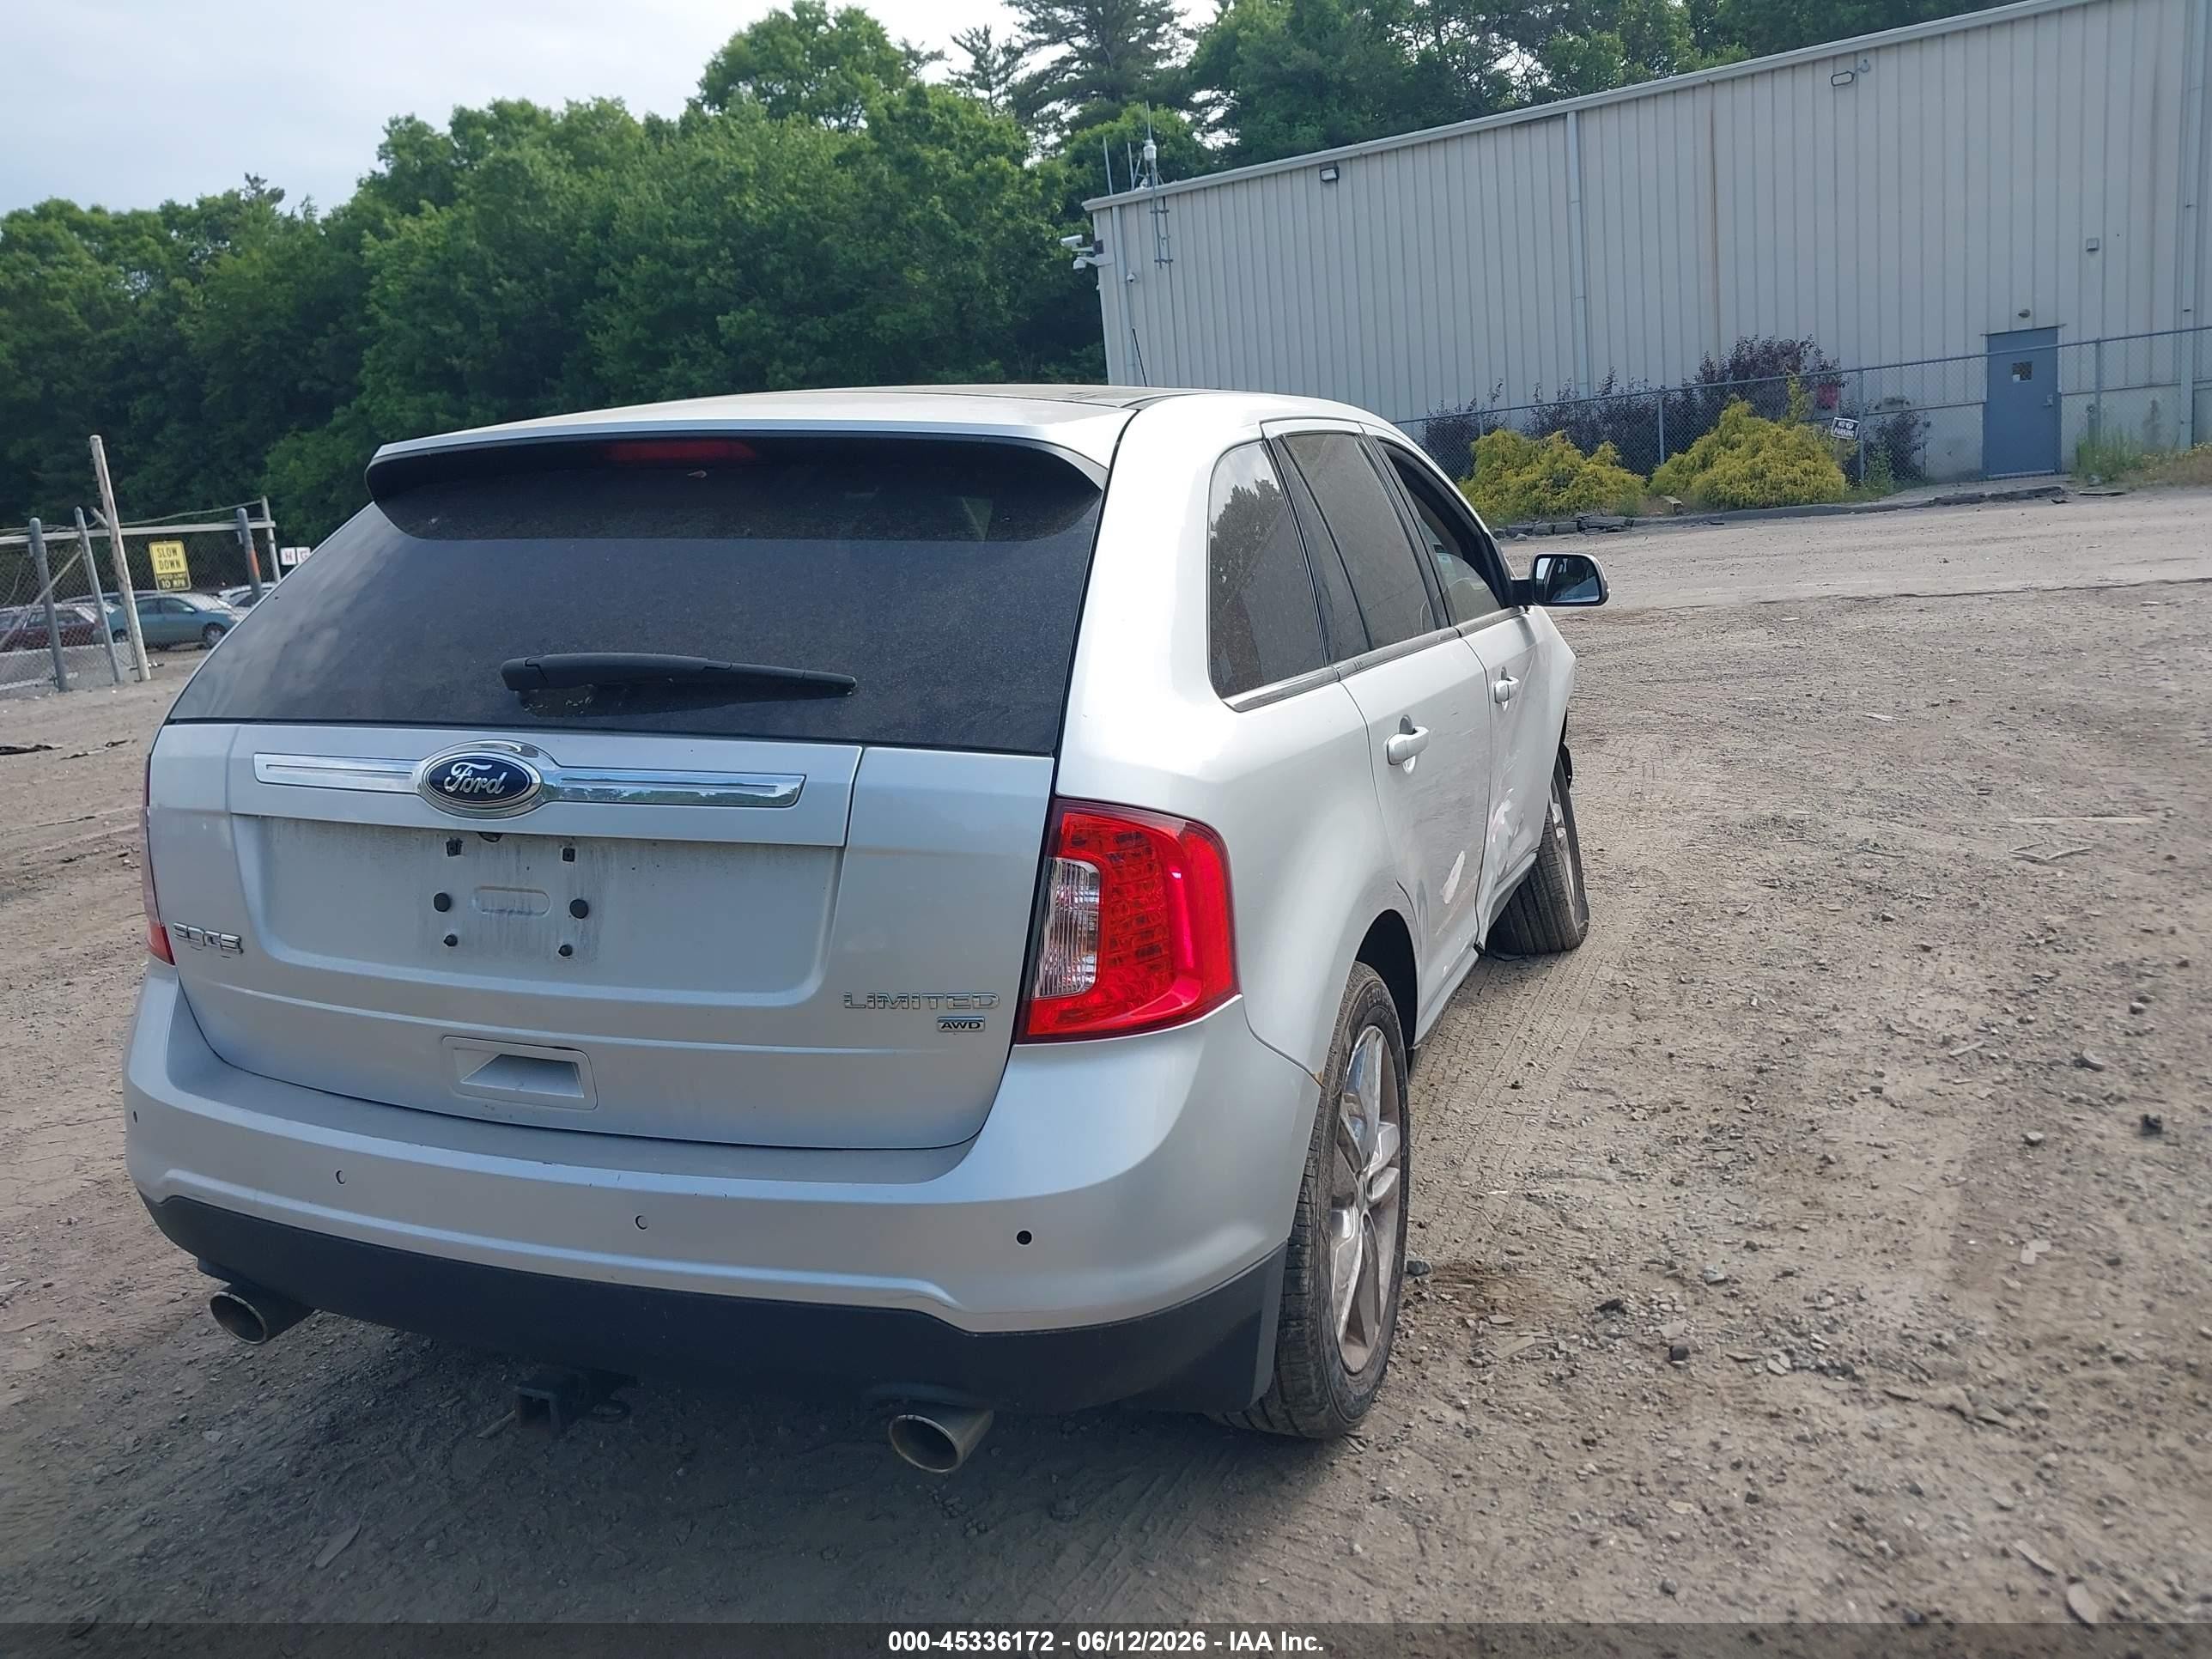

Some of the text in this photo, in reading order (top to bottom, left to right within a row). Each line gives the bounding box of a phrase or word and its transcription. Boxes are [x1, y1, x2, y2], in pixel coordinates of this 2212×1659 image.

[156, 546, 178, 558] SLOW
[285, 550, 293, 562] H
[158, 559, 181, 570] DOWN
[161, 579, 172, 589] 10
[443, 762, 507, 794] Ford
[843, 992, 1000, 1010] LIMITED
[940, 1021, 981, 1030] AWD
